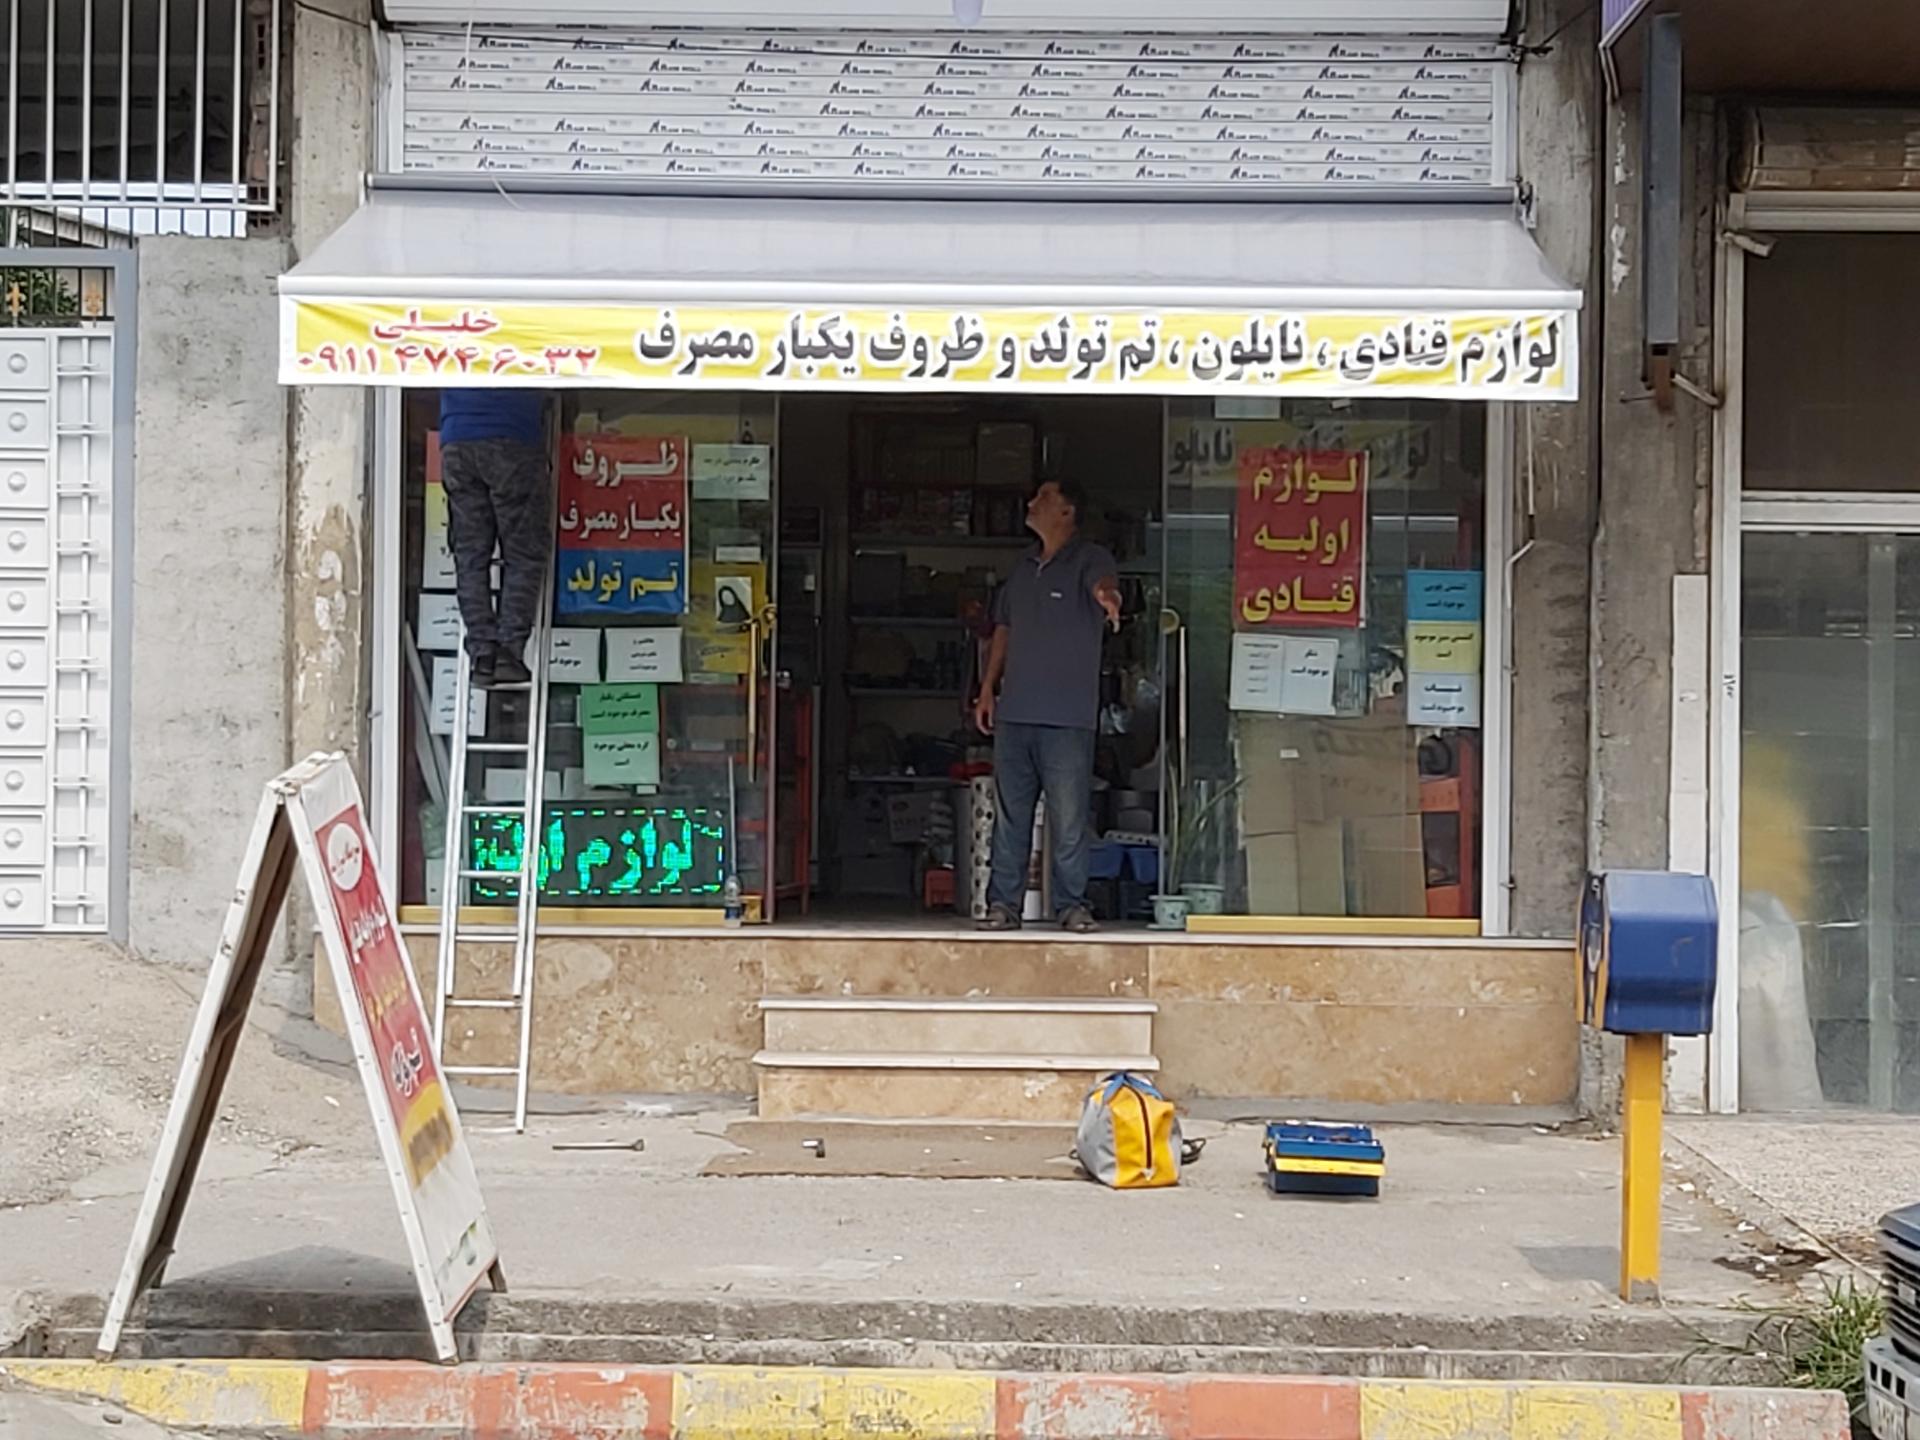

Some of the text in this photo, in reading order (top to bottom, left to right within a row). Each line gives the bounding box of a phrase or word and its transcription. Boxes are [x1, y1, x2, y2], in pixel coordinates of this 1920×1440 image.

[374, 310, 498, 339] خلیلی
[639, 311, 754, 375] مصرف
[766, 313, 856, 376] یکبار
[870, 313, 984, 378] ظروف
[1029, 315, 1108, 380] تولد
[996, 336, 1016, 379] و
[1120, 319, 1157, 381] تم
[1461, 319, 1560, 383] لوازم
[572, 439, 679, 487] ظروف
[1253, 456, 1357, 504] لوازم
[560, 499, 681, 539] یکبار مصرف
[1253, 515, 1349, 565] اولیه
[567, 559, 679, 602] تم تولد
[1242, 575, 1356, 623] قنادی
[577, 816, 693, 890] لوازم
